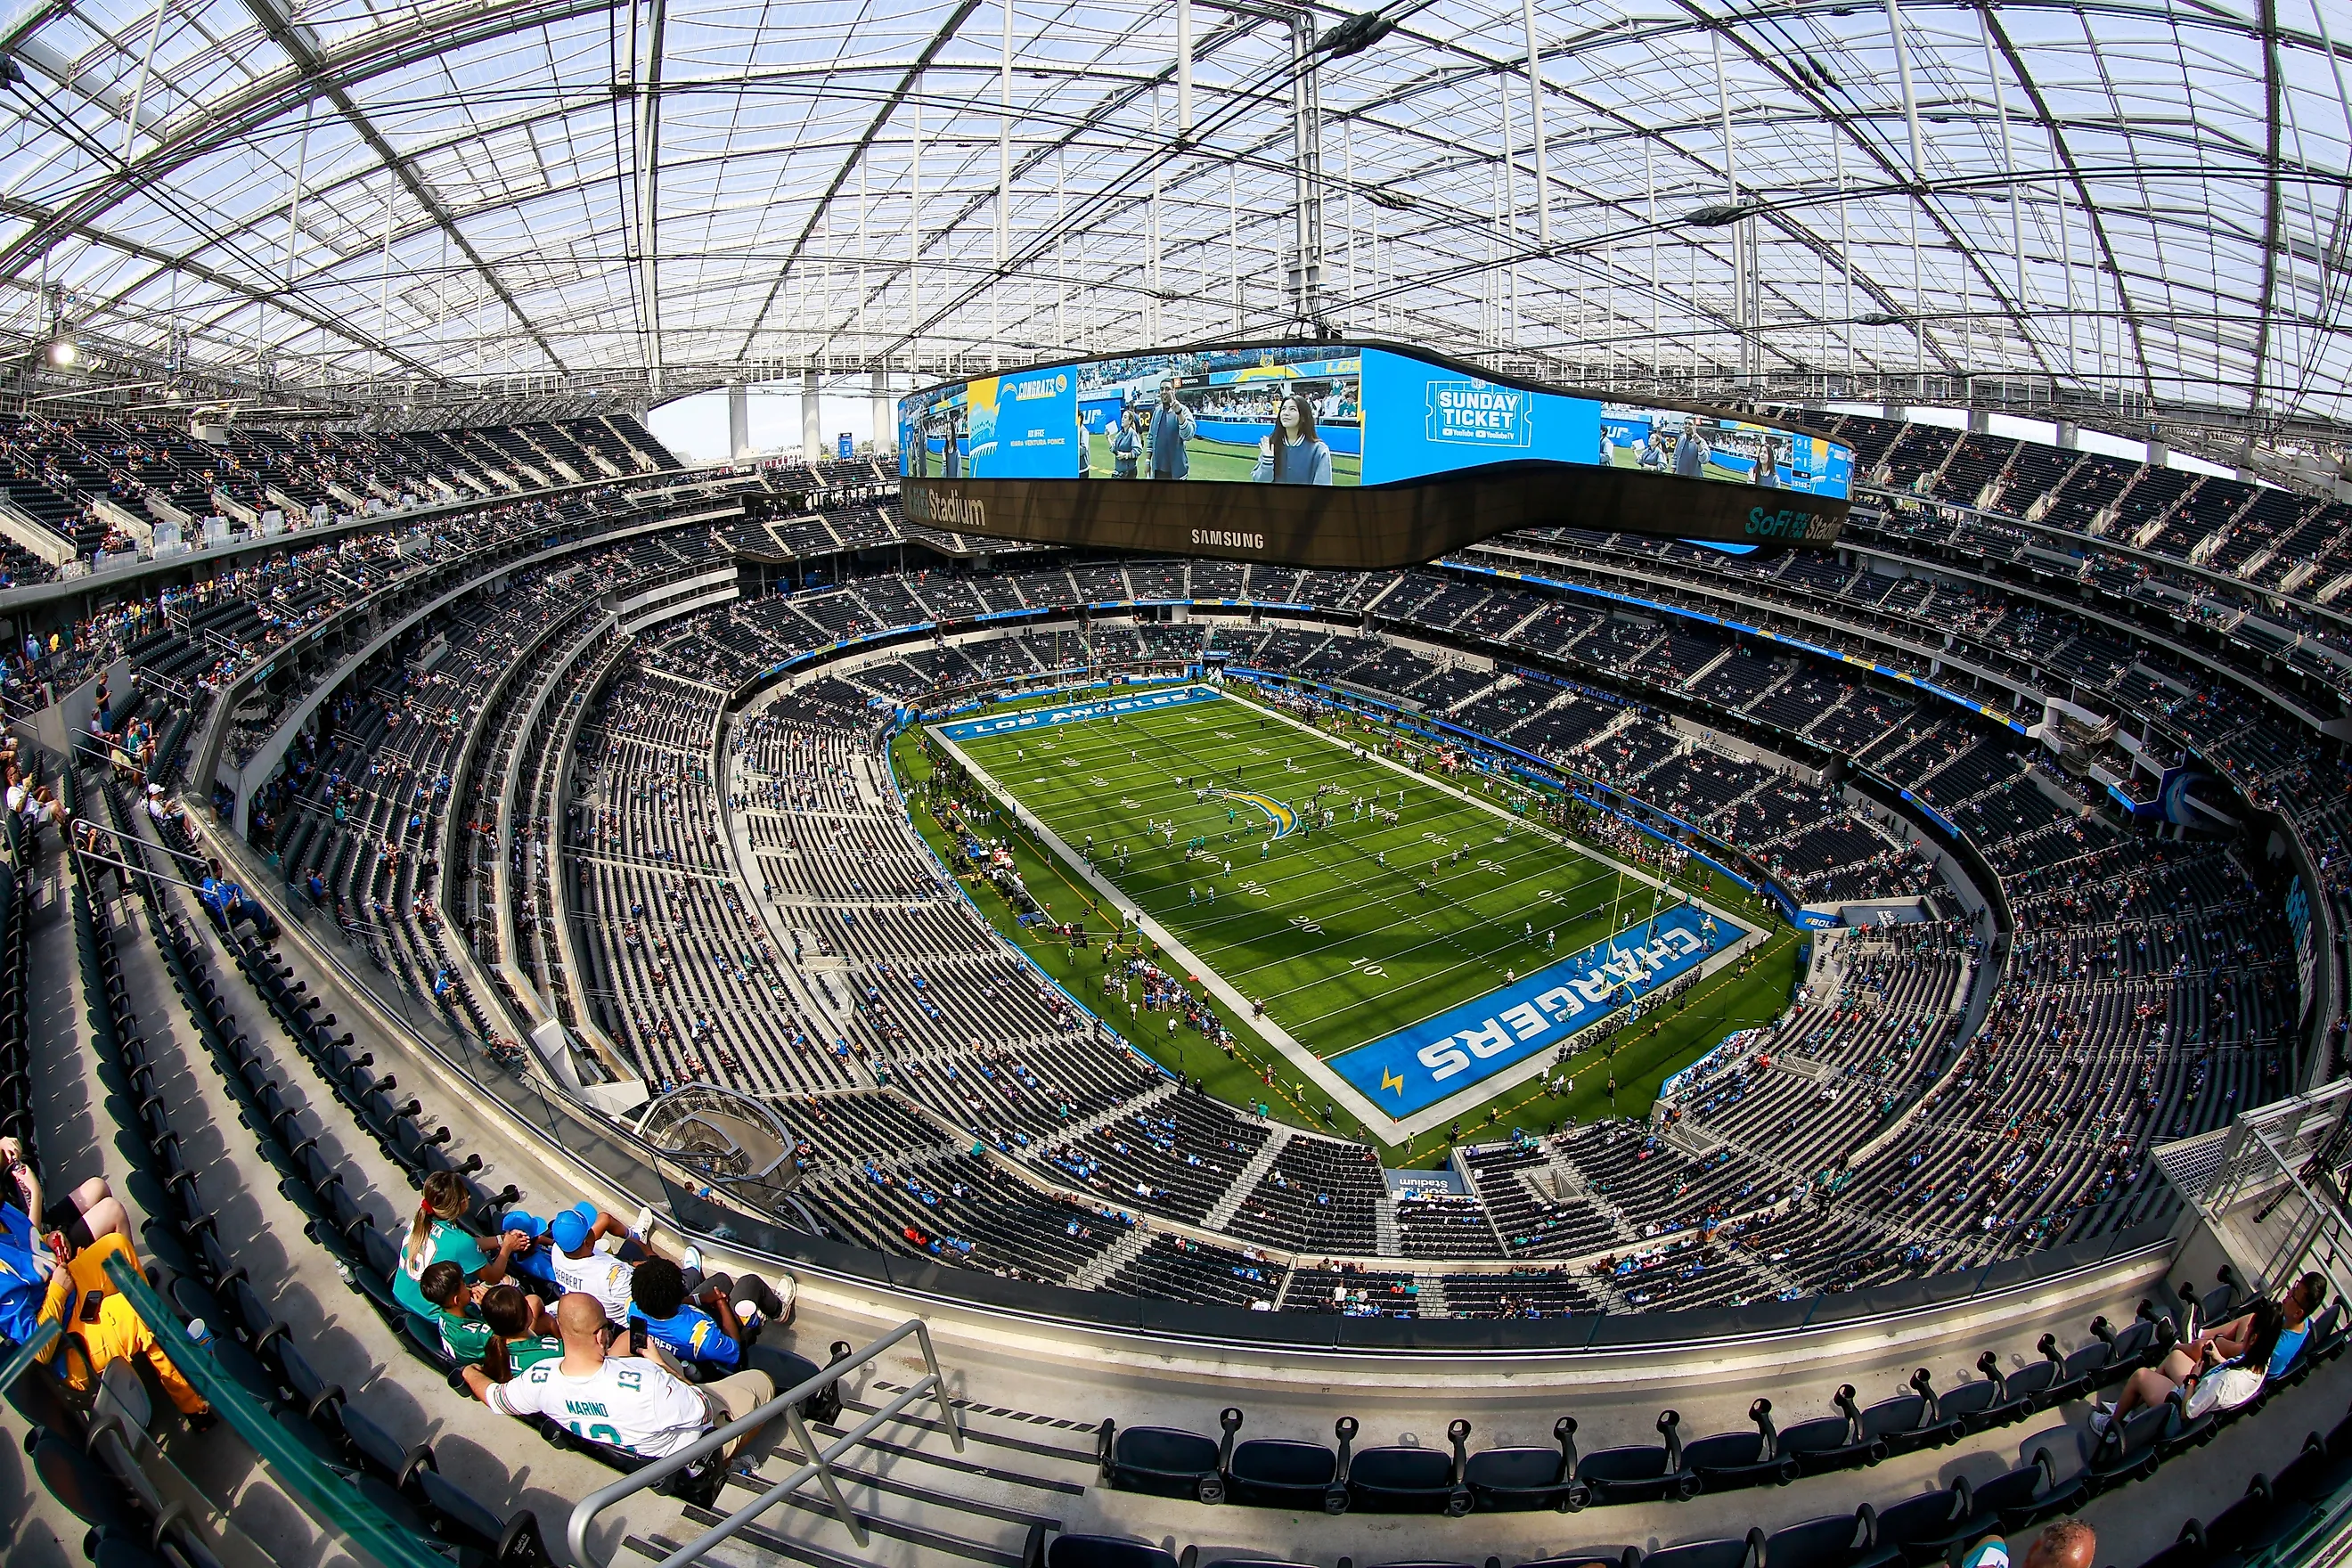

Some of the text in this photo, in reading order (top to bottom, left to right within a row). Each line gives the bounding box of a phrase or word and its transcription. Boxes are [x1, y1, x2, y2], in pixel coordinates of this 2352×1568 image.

[1473, 380, 1483, 388] NFL
[1439, 391, 1518, 411] SUNDAY
[1082, 409, 1102, 425] UP
[1442, 408, 1514, 429] TICKET
[1453, 429, 1474, 437] YouTube
[928, 488, 985, 527] Stadium
[1745, 506, 1793, 537] SoFi
[1191, 528, 1264, 549] SAMSUNG
[976, 715, 1038, 733] LOS
[1049, 693, 1189, 724] ANGELES
[1421, 831, 1447, 846] 30
[1515, 818, 1560, 842] KICKOFF
[1476, 859, 1505, 875] 20
[1237, 880, 1266, 896] 30
[1538, 889, 1566, 907] 10
[1288, 915, 1321, 935] 20
[1348, 956, 1384, 976] 10
[1416, 927, 1703, 1082] CHARGERS
[1400, 1179, 1449, 1188] Stadium
[531, 1365, 551, 1384] 13
[617, 1370, 641, 1392] 13
[565, 1399, 609, 1417] MARINO
